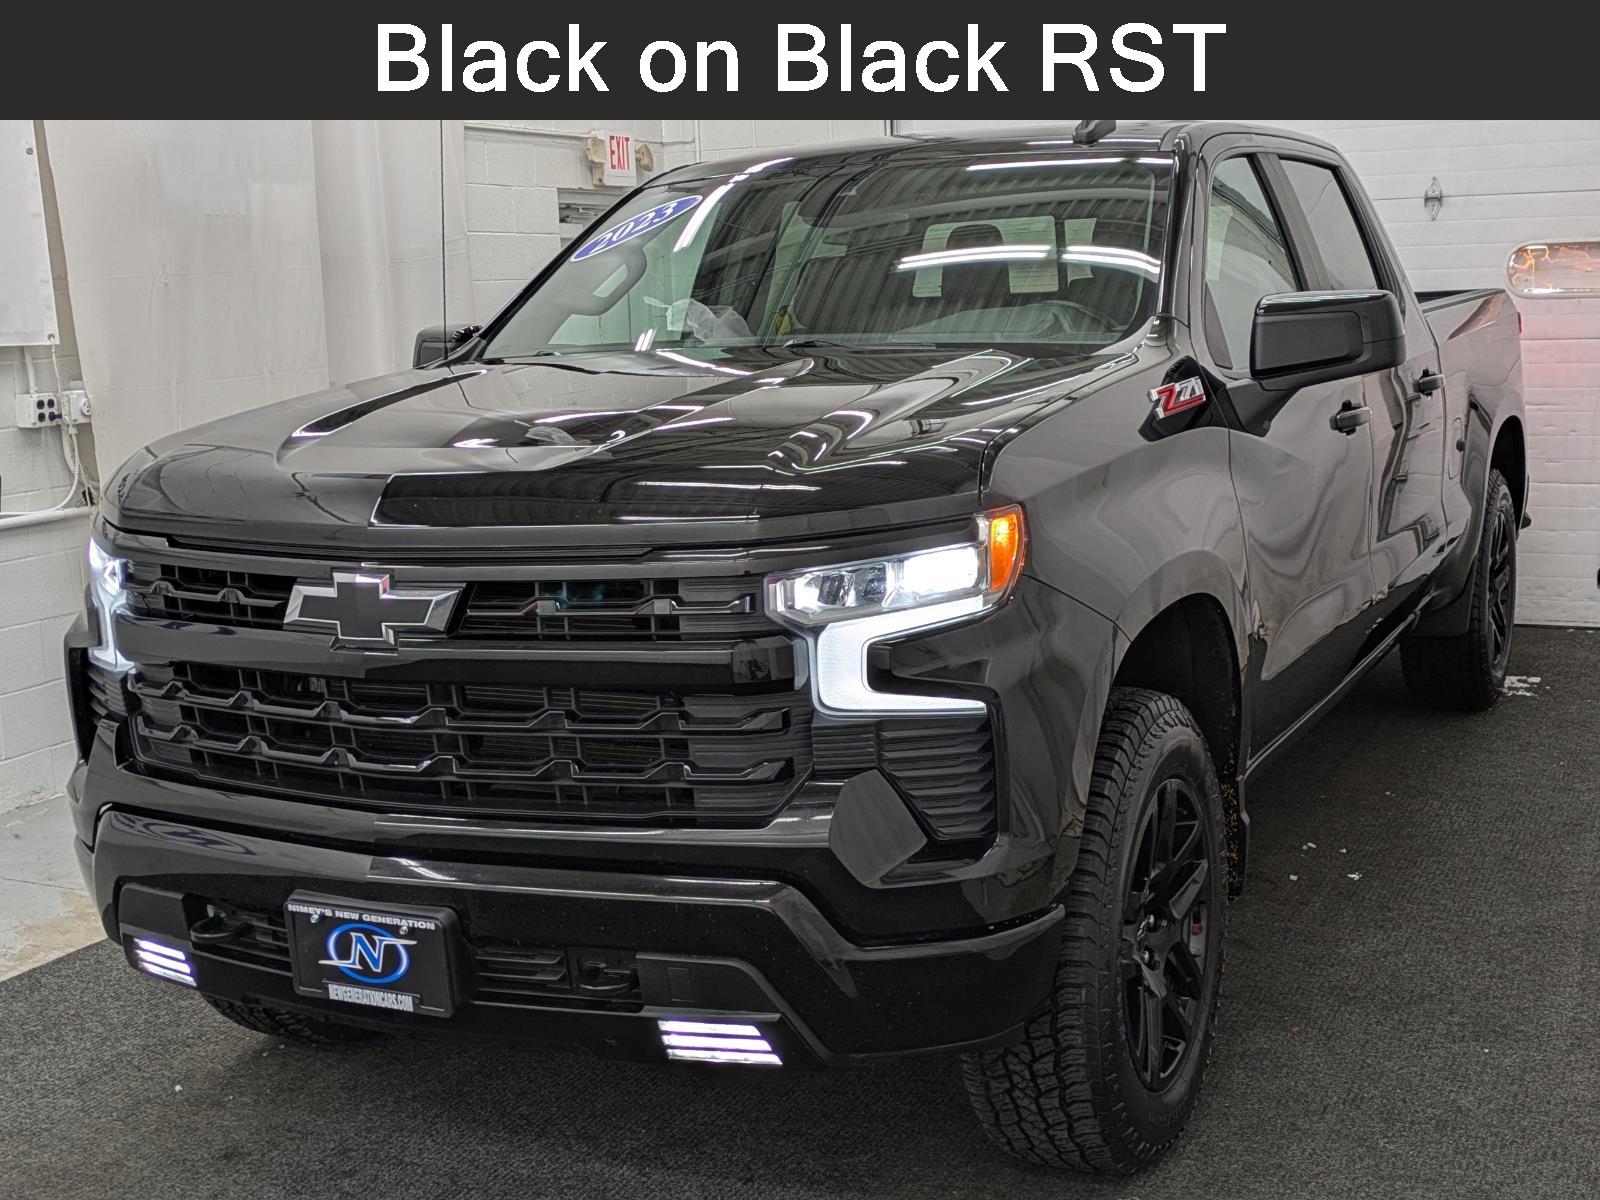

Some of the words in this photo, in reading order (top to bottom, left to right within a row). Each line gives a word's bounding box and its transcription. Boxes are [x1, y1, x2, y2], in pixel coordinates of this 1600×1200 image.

[609, 135, 630, 171] EXIT
[588, 202, 678, 256] 2023
[1147, 376, 1207, 420] Z71
[287, 903, 333, 917] NIMEY'S
[334, 910, 360, 921] NEW
[361, 914, 436, 931] GENERATION
